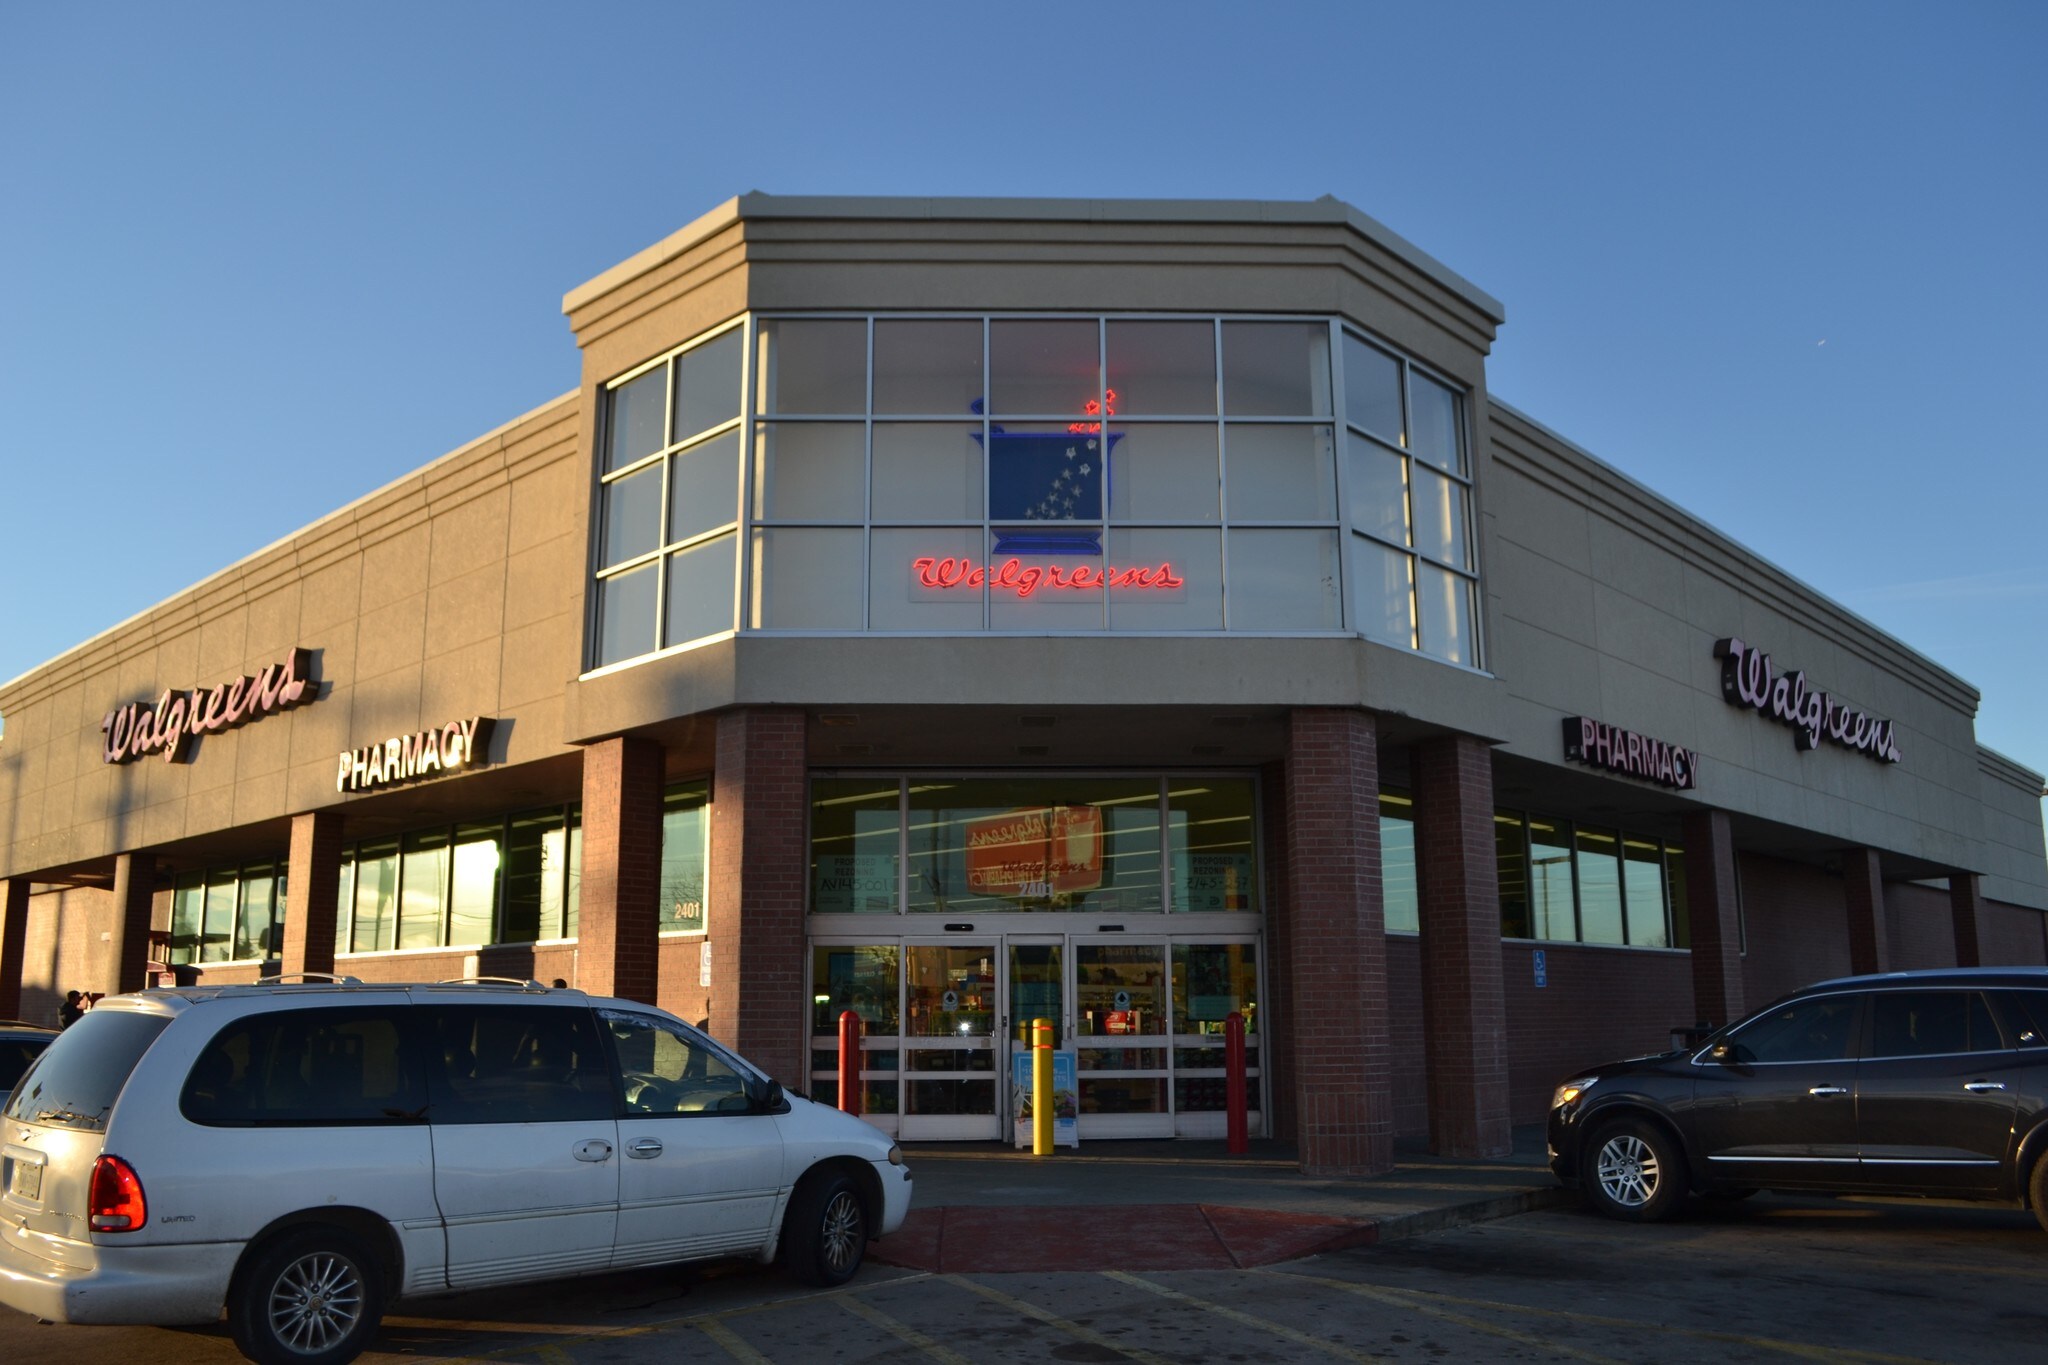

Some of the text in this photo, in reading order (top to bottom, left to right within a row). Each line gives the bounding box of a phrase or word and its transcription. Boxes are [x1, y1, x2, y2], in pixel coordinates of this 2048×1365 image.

[913, 557, 1183, 597] Walgreens
[102, 647, 307, 763] Walgreens
[1729, 637, 1902, 763] Walgreens
[337, 716, 480, 792] PHARMACY
[1580, 716, 1698, 788] PHARMACY
[834, 857, 876, 866] PROPOSED
[1000, 861, 1087, 876] Walgreens
[1192, 856, 1233, 865] PROPOSED
[835, 867, 875, 876] REZONING
[1193, 866, 1233, 875] REZONING
[1019, 882, 1055, 898] 2401
[674, 902, 700, 918] 2401
